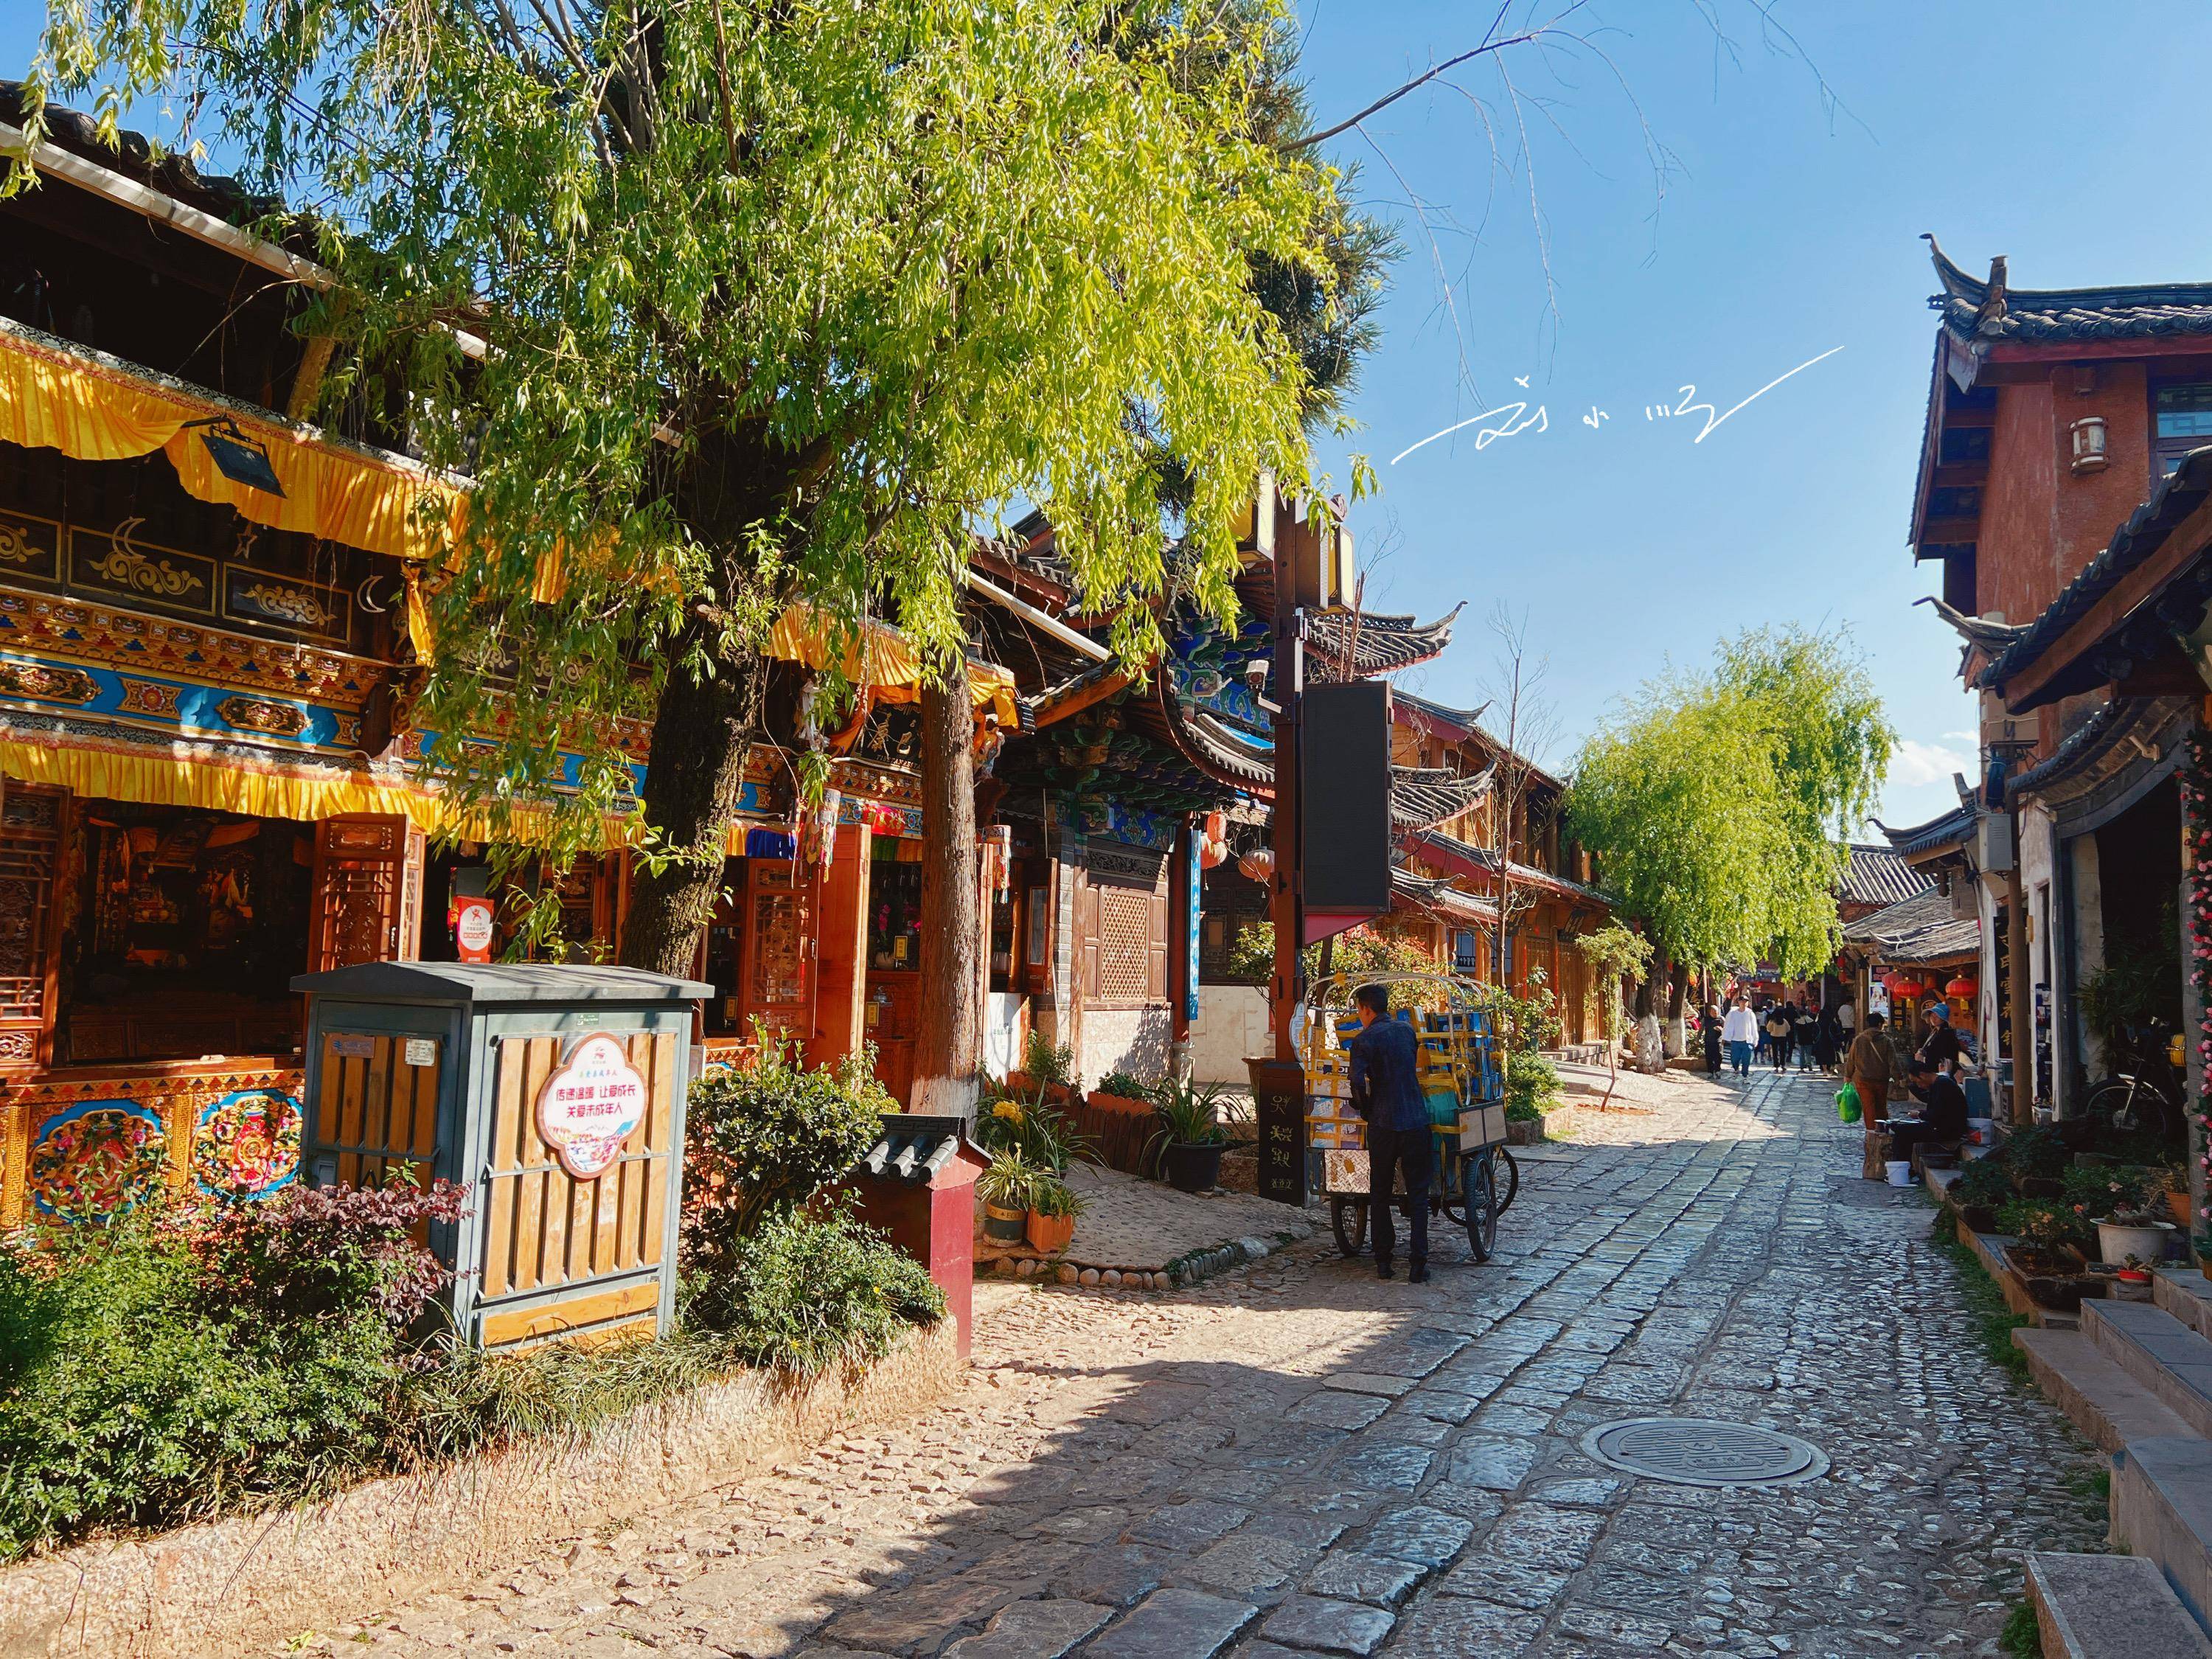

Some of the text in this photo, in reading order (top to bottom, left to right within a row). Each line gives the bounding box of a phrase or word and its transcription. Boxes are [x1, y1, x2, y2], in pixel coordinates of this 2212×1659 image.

[556, 1084, 636, 1102] 传递温暖 让爱成长
[566, 1102, 623, 1119] 关爱未成年人
